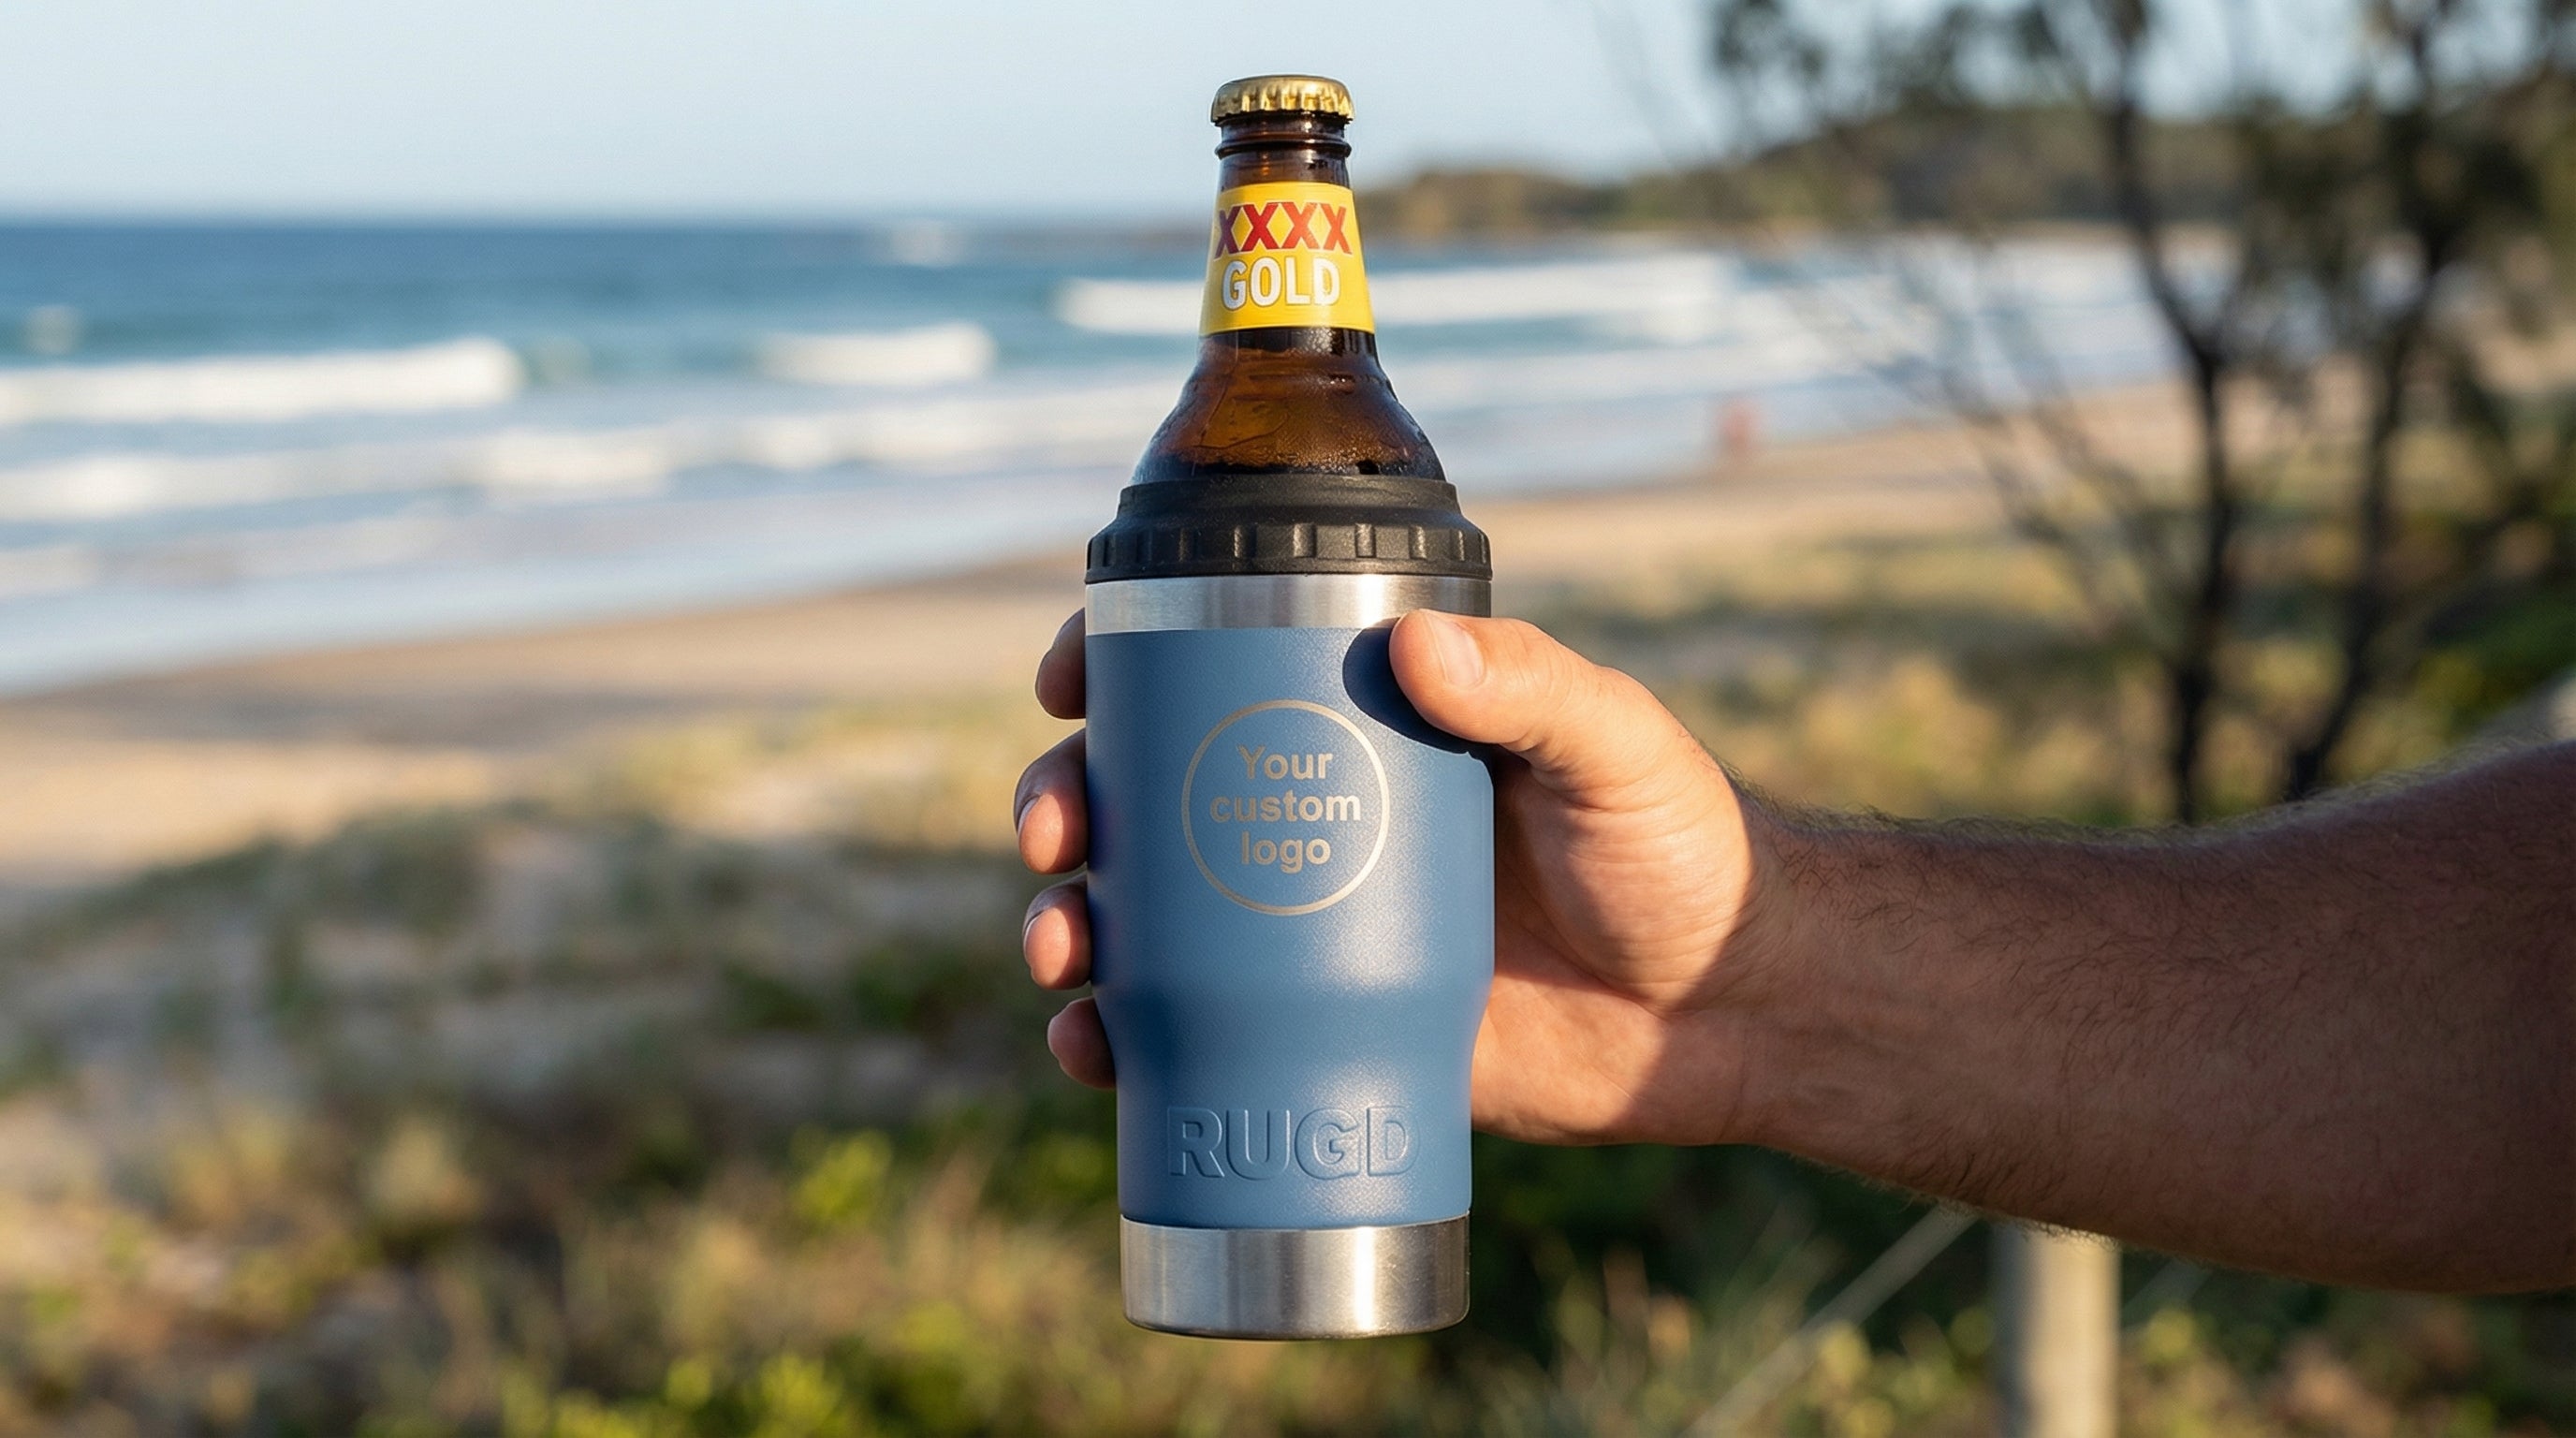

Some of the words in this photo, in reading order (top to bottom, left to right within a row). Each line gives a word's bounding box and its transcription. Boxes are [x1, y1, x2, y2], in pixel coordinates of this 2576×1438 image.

[1214, 201, 1353, 259] XXXX
[1222, 257, 1340, 311] GOLD
[1237, 744, 1333, 780] Your
[1209, 789, 1361, 822] custom
[1241, 830, 1331, 873] logo
[1167, 1107, 1420, 1181] RUGD
